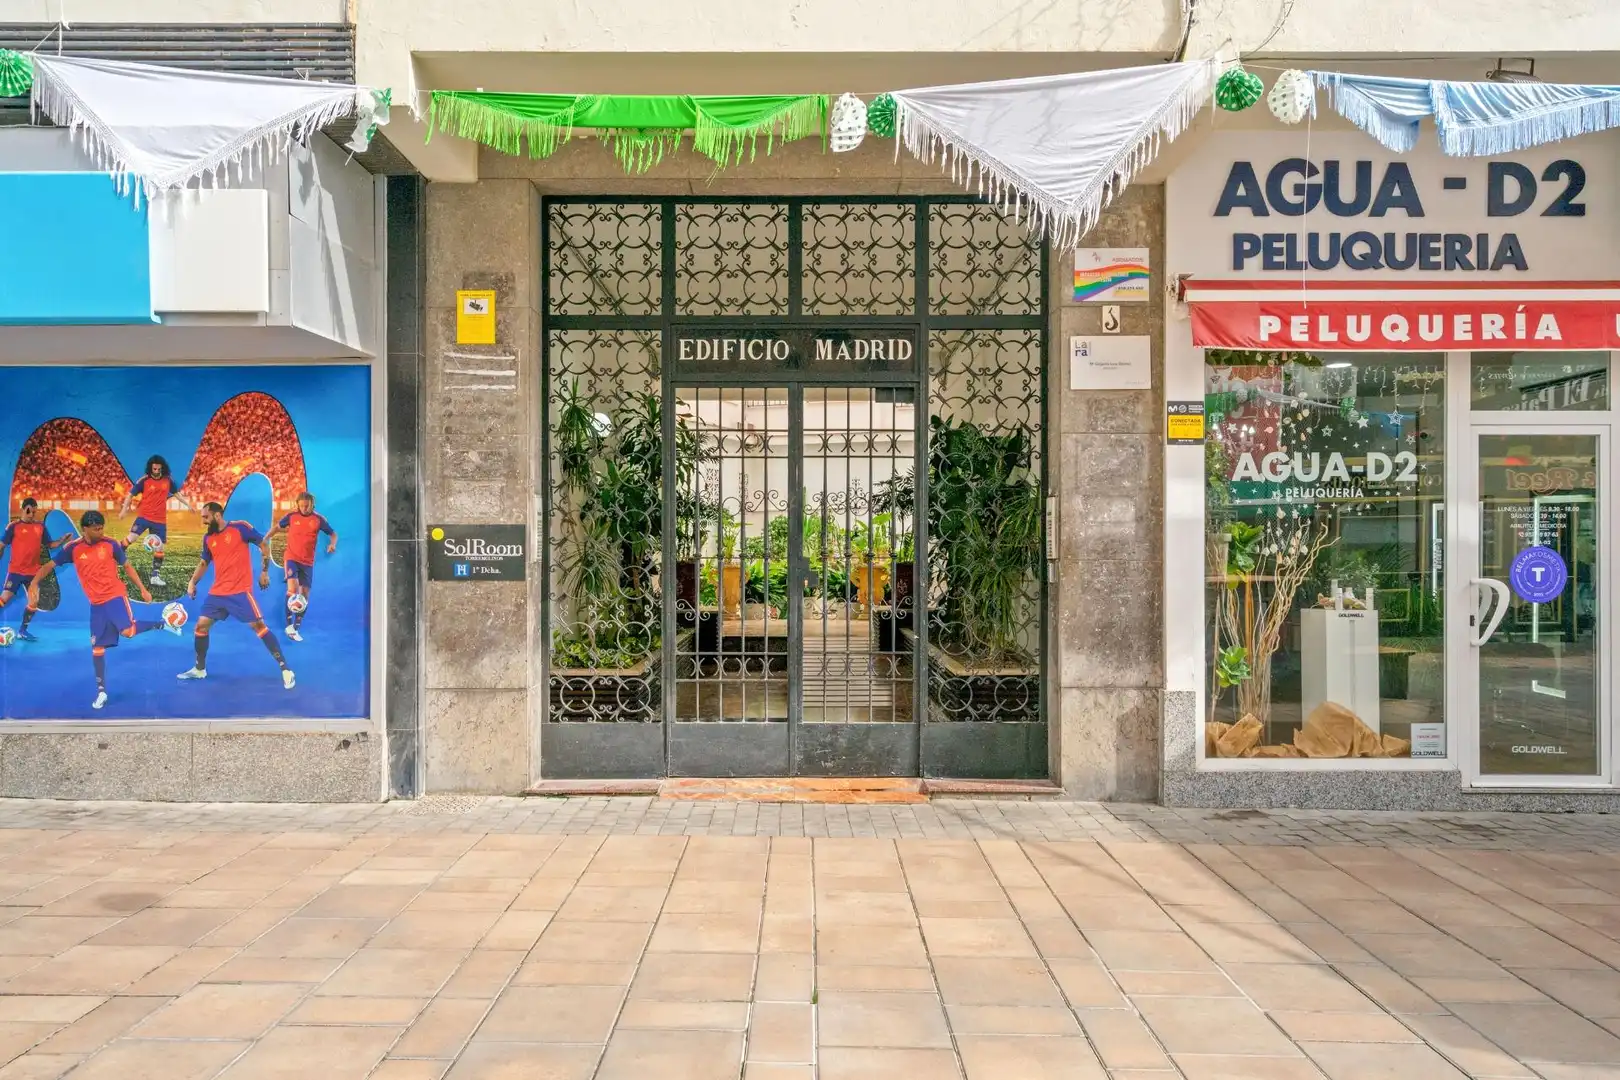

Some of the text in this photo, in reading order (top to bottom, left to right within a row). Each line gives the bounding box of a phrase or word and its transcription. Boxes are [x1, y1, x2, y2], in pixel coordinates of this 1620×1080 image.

[1213, 158, 1425, 217] AGUA
[1487, 159, 1587, 217] D2
[1233, 231, 1529, 270] PELUQUERIA
[1259, 304, 1563, 342] PELUQUERÍA
[679, 339, 913, 361] EDIFICIO MADRID
[1231, 451, 1418, 482] AGUA-D2
[1285, 485, 1364, 499] PELUQUERÍA
[444, 538, 523, 556] SolRoom
[1531, 567, 1546, 582] T
